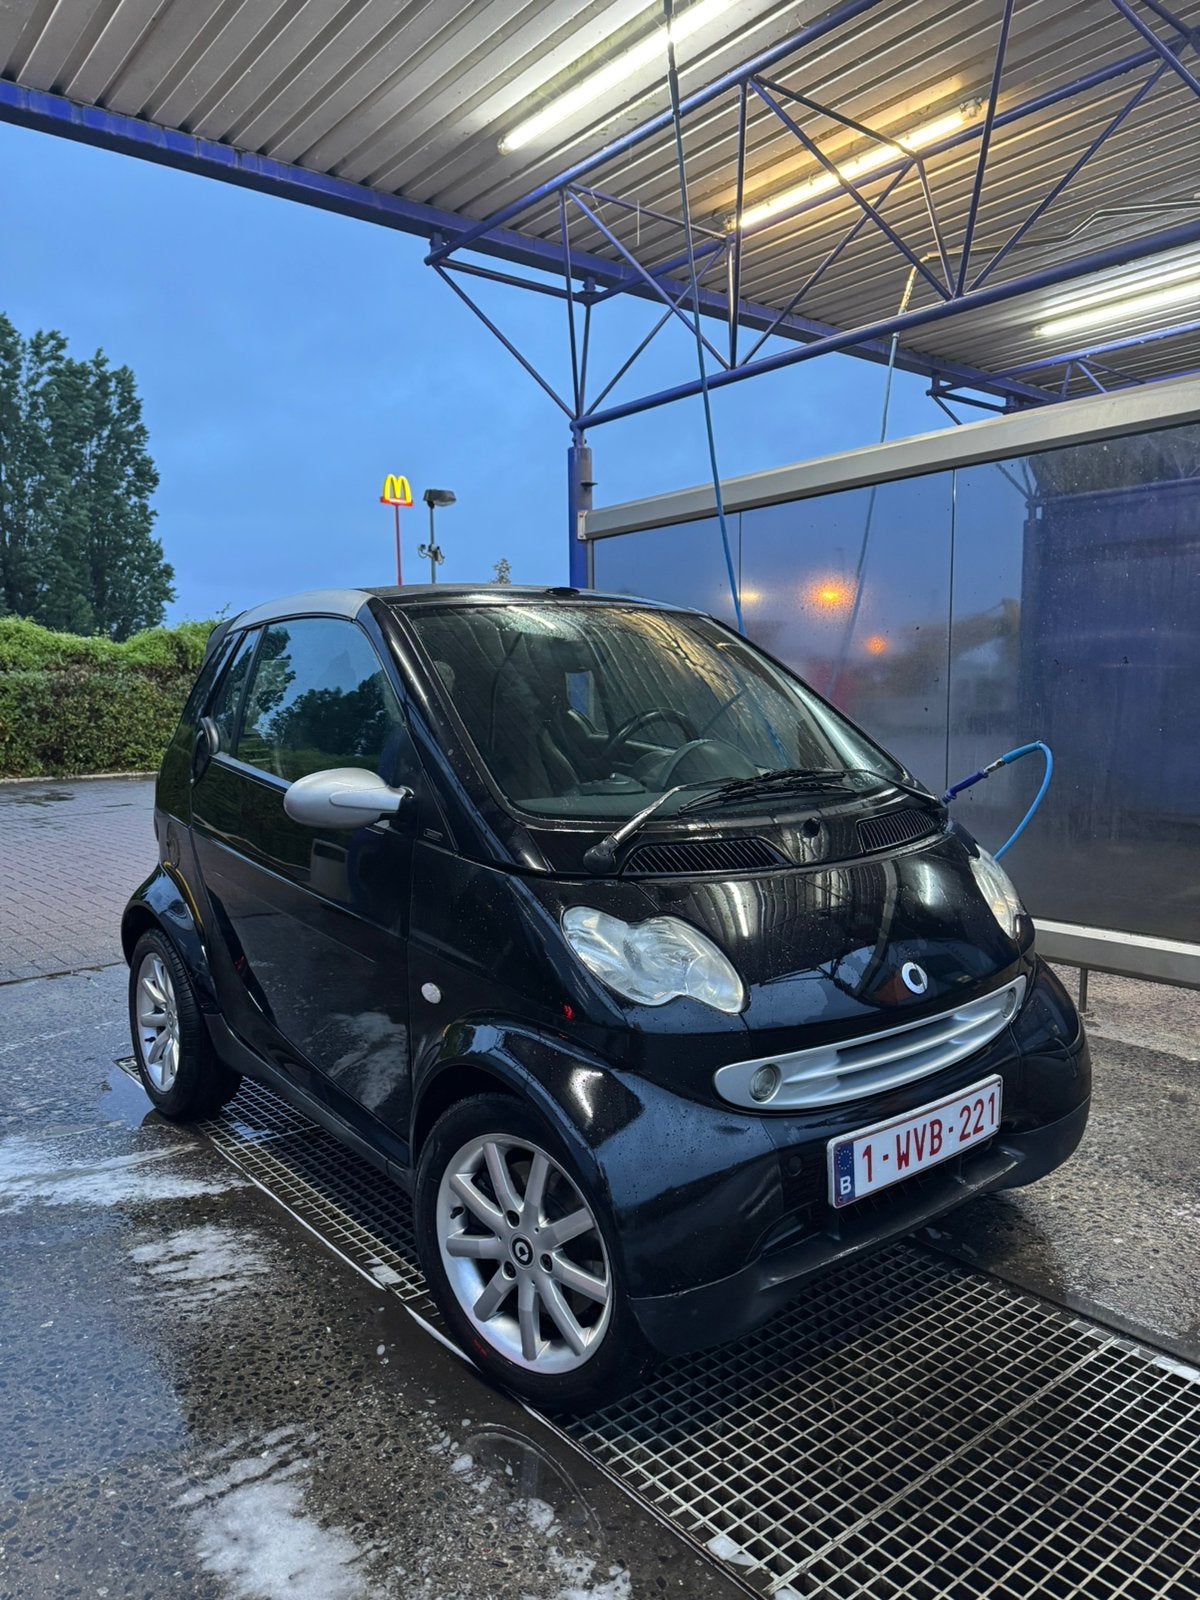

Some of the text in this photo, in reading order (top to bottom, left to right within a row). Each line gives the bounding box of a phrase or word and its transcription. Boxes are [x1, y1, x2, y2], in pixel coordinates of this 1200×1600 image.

[383, 474, 412, 503] M
[862, 1092, 995, 1183] 1-WVB-221
[839, 1175, 851, 1195] B
